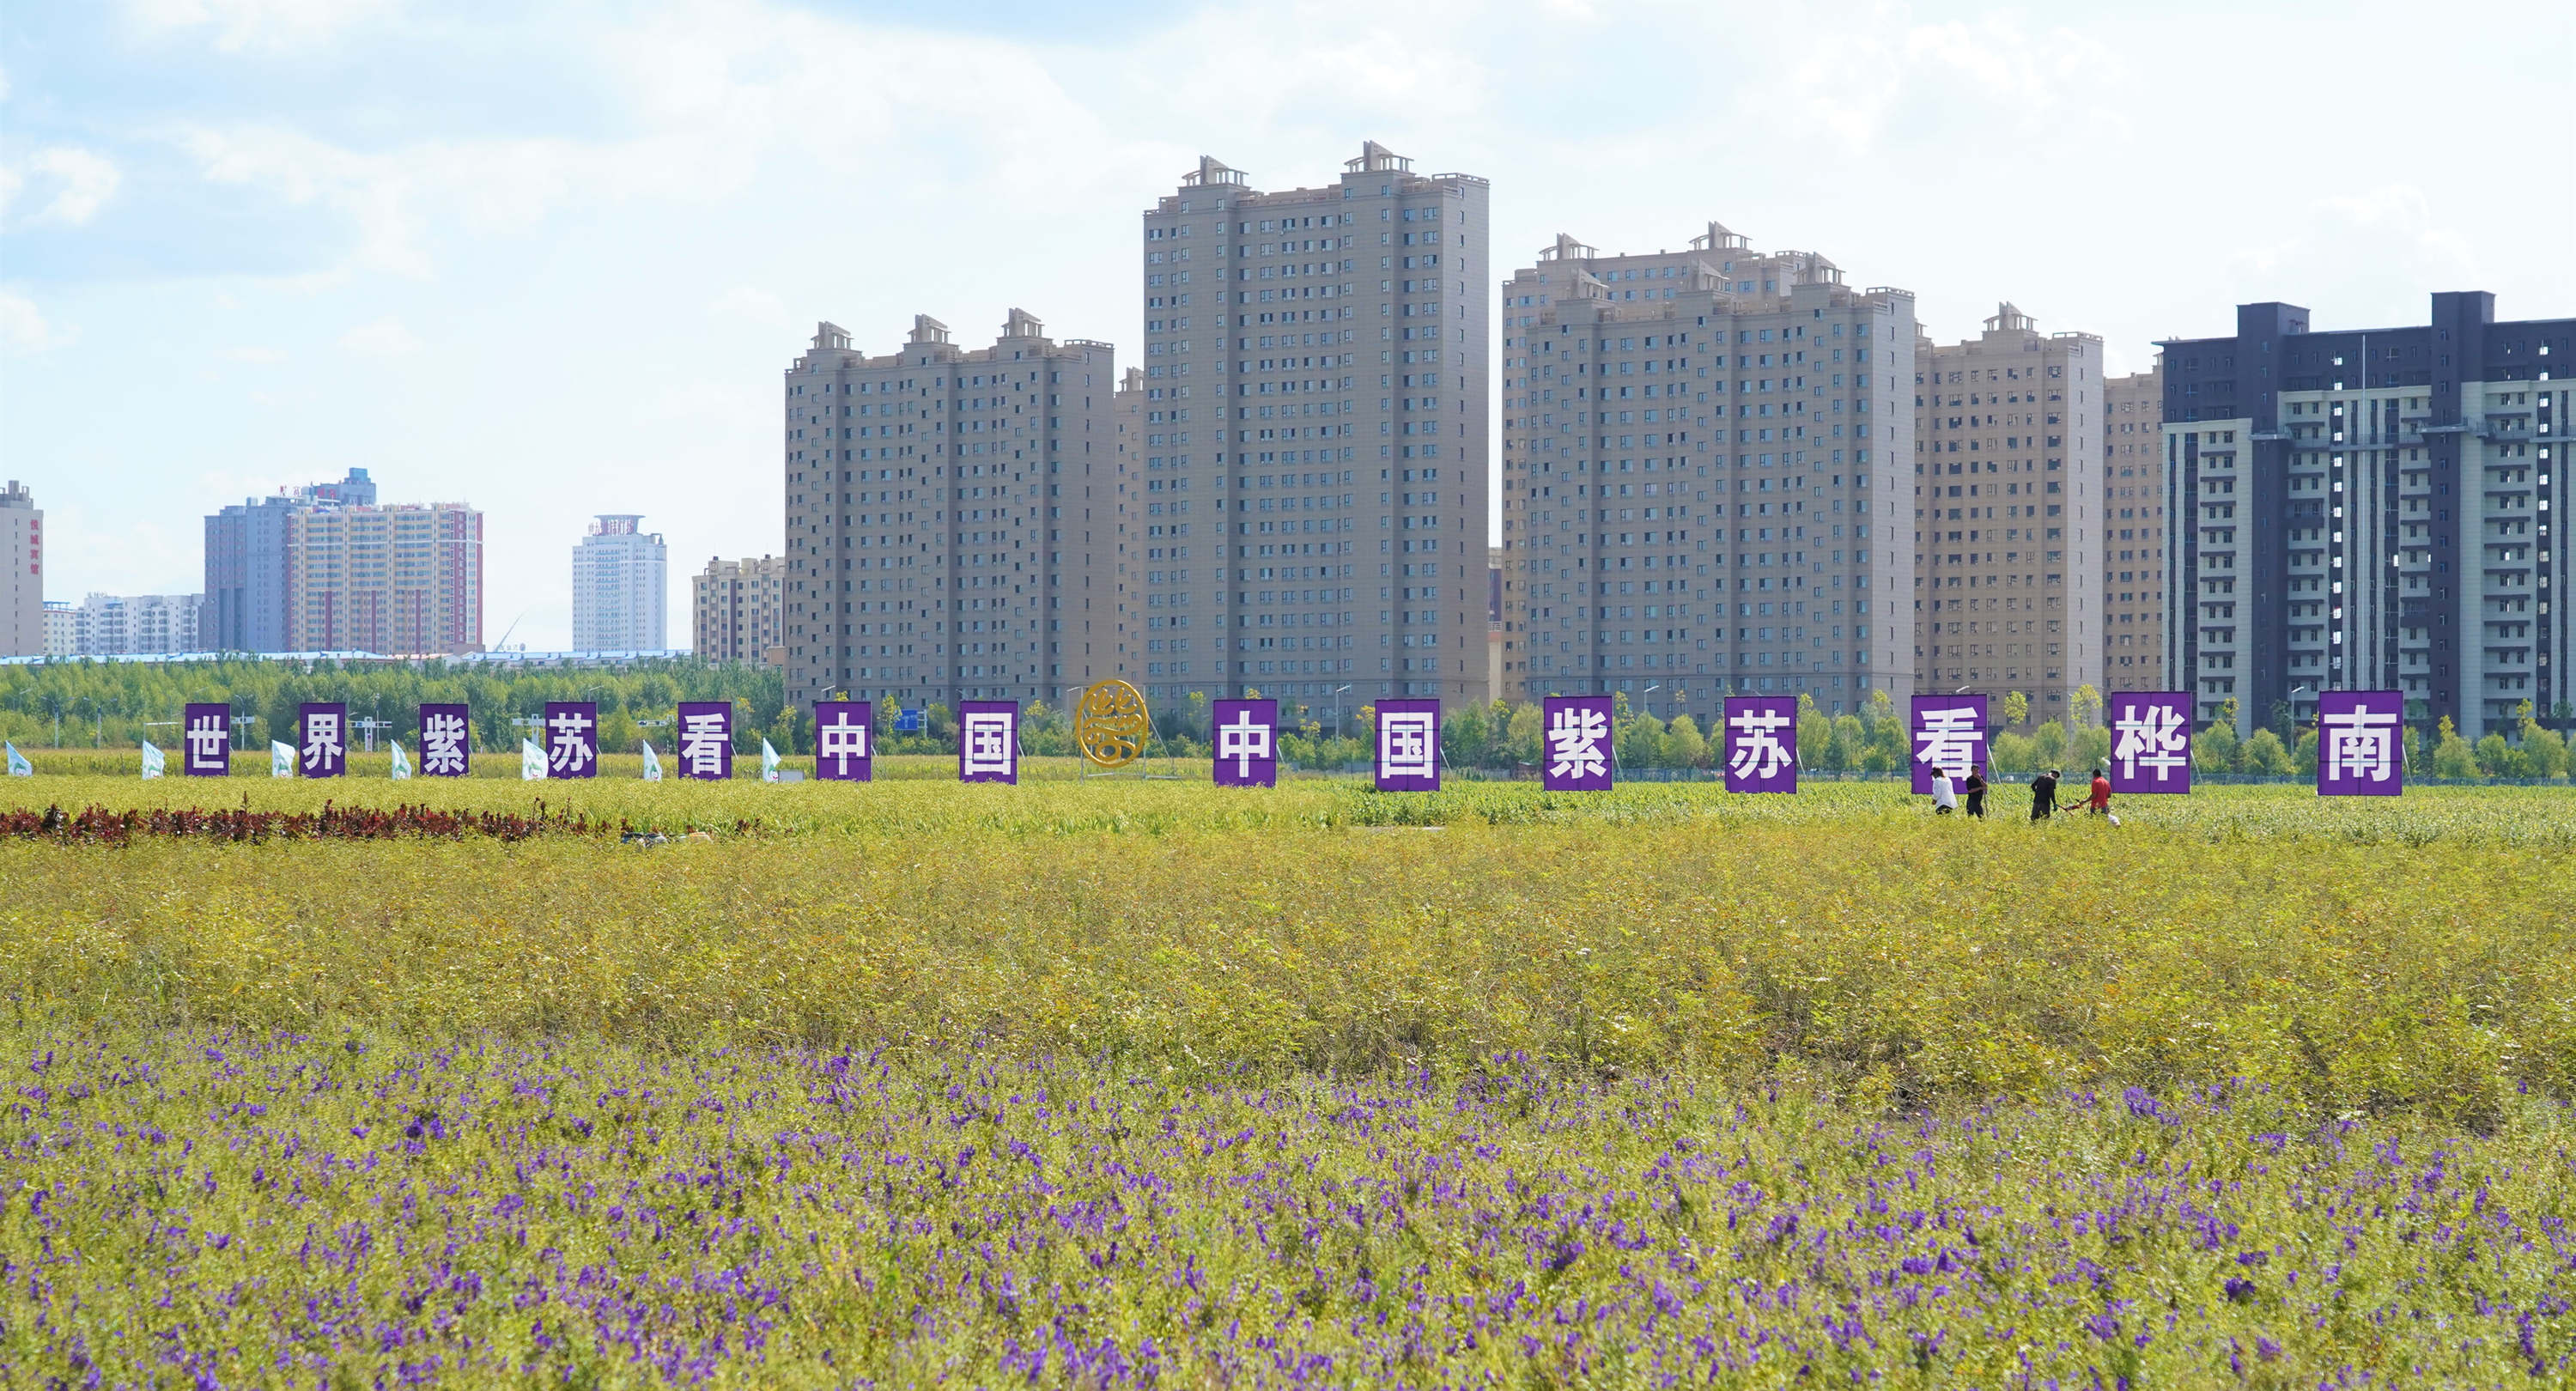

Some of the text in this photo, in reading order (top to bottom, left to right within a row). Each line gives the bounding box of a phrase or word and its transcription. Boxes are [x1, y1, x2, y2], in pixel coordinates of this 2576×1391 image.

[186, 715, 228, 768] 世
[303, 714, 342, 770] 界
[423, 714, 465, 773] 紫
[549, 713, 594, 772] 苏
[682, 714, 729, 774] 看
[822, 712, 866, 775] 中
[964, 713, 1012, 775] 国
[1219, 711, 1270, 778] 中
[1381, 713, 1434, 779] 国
[1548, 708, 1607, 780] 紫
[1729, 710, 1793, 780] 苏
[1917, 707, 1983, 781] 看
[2115, 706, 2187, 781] 桦
[2324, 704, 2397, 782] 南
